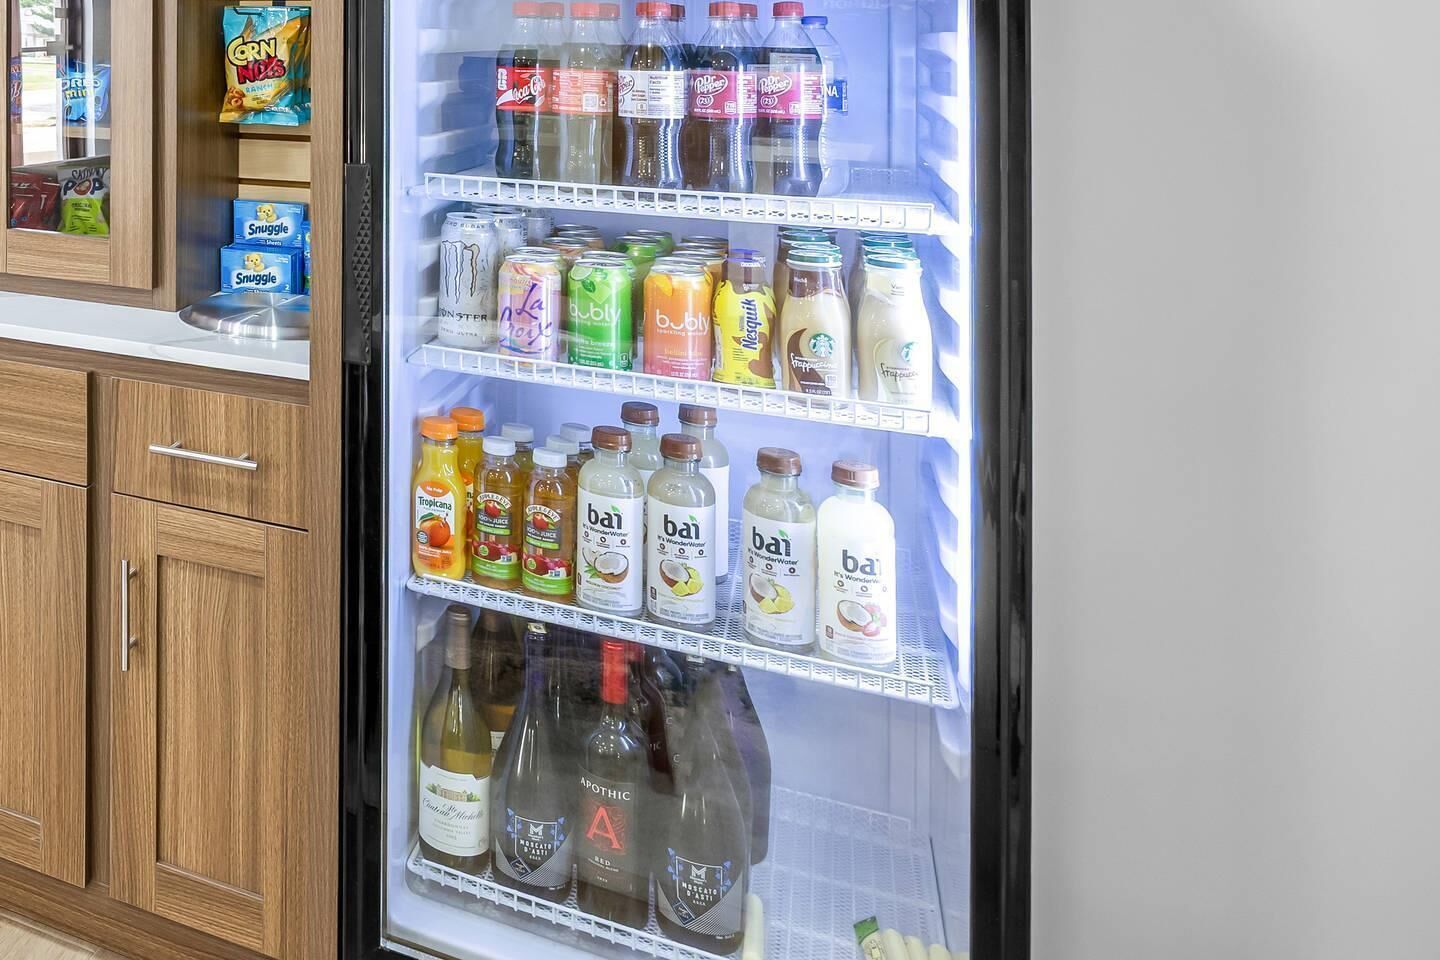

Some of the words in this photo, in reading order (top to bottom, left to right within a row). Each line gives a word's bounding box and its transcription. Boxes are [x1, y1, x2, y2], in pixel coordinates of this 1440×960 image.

[227, 36, 276, 66] CORN
[236, 57, 286, 84] NUTS
[704, 75, 716, 83] Dr
[246, 83, 273, 94] RANCH
[695, 77, 725, 93] Pepper
[759, 78, 789, 94] Pepper
[248, 222, 289, 236] Snuggle
[236, 272, 277, 286] Snuggle
[515, 282, 544, 320] La
[570, 298, 621, 326] bubly
[656, 309, 710, 335] bubly
[741, 298, 762, 351] Nesquik
[418, 496, 452, 511] Tropicana
[588, 503, 623, 529] bai
[663, 514, 700, 540] bai
[752, 526, 791, 557] bai
[580, 776, 631, 801] APOTHIC
[586, 806, 623, 849] A
[520, 839, 552, 850] MOSCATO
[594, 855, 611, 866] RED
[681, 881, 718, 895] MOSCATO
